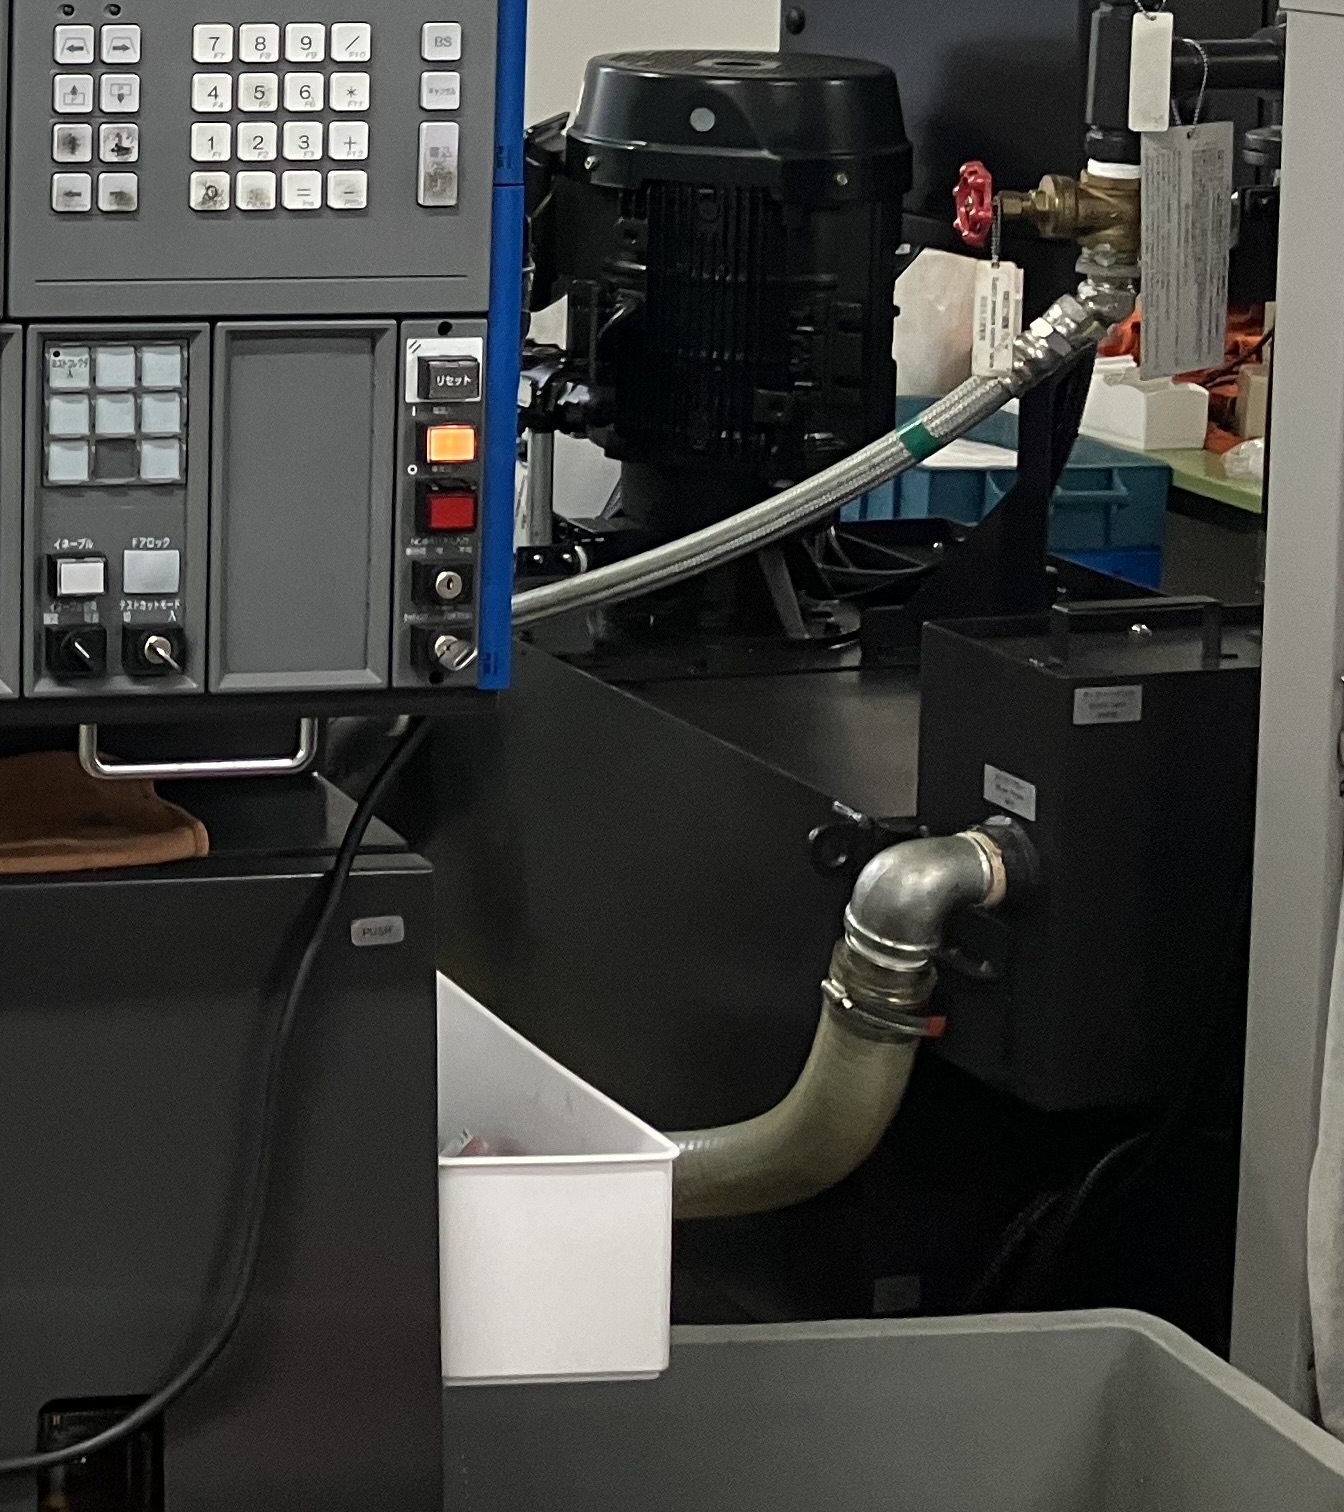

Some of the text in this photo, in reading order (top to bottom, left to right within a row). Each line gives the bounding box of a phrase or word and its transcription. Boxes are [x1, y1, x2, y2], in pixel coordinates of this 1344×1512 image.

[209, 37, 219, 51] 7
[301, 37, 312, 50] 9
[435, 36, 452, 47] BS
[208, 86, 219, 100] 4
[436, 375, 471, 386] リセット
[132, 538, 170, 548] ドアロック
